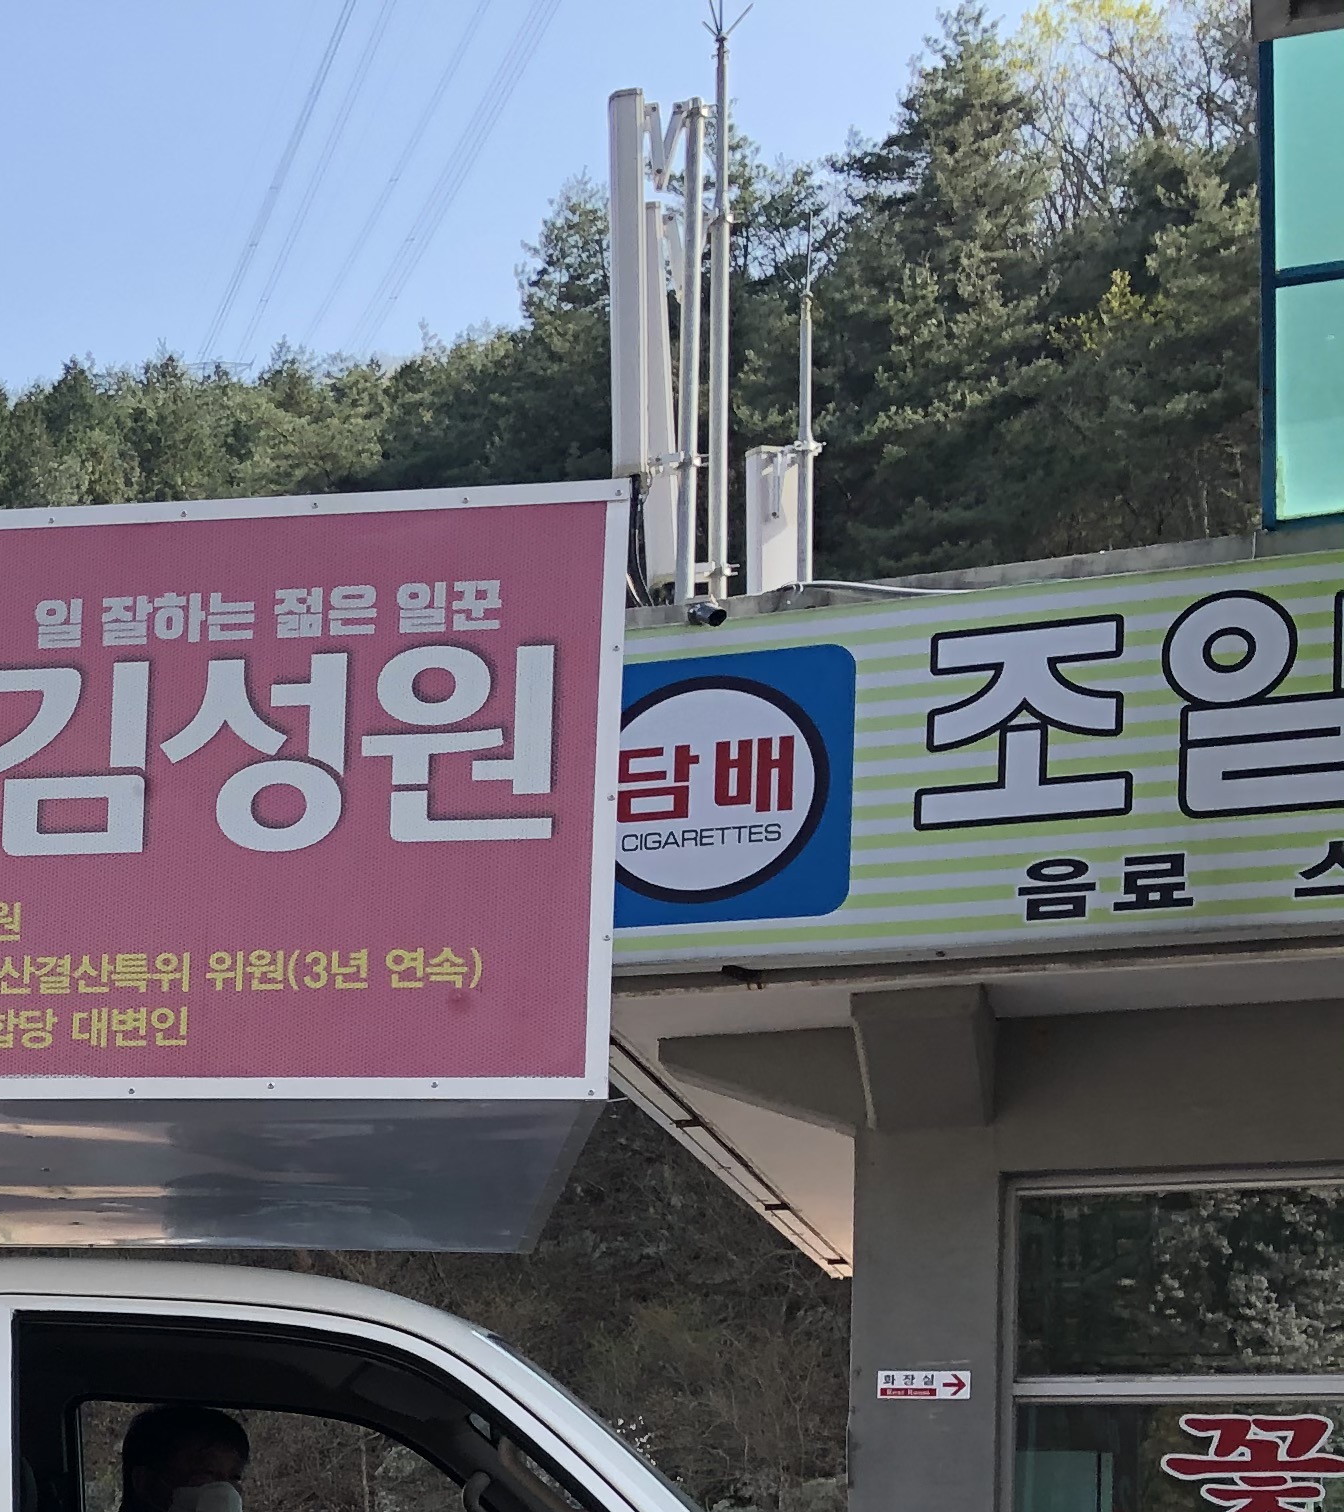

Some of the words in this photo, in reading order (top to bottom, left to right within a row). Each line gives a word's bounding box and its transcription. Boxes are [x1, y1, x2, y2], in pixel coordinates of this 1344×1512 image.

[35, 596, 83, 650] 일
[101, 589, 256, 645] 잘하는
[273, 583, 377, 639] 젊은
[396, 578, 504, 634] 일꾼
[616, 735, 795, 825] 담배
[620, 823, 782, 853] CIGARETTES
[1016, 852, 1196, 922] 음료
[205, 947, 370, 994] 위원(3년
[386, 945, 486, 993] 연속)
[72, 1005, 190, 1049] 대변인
